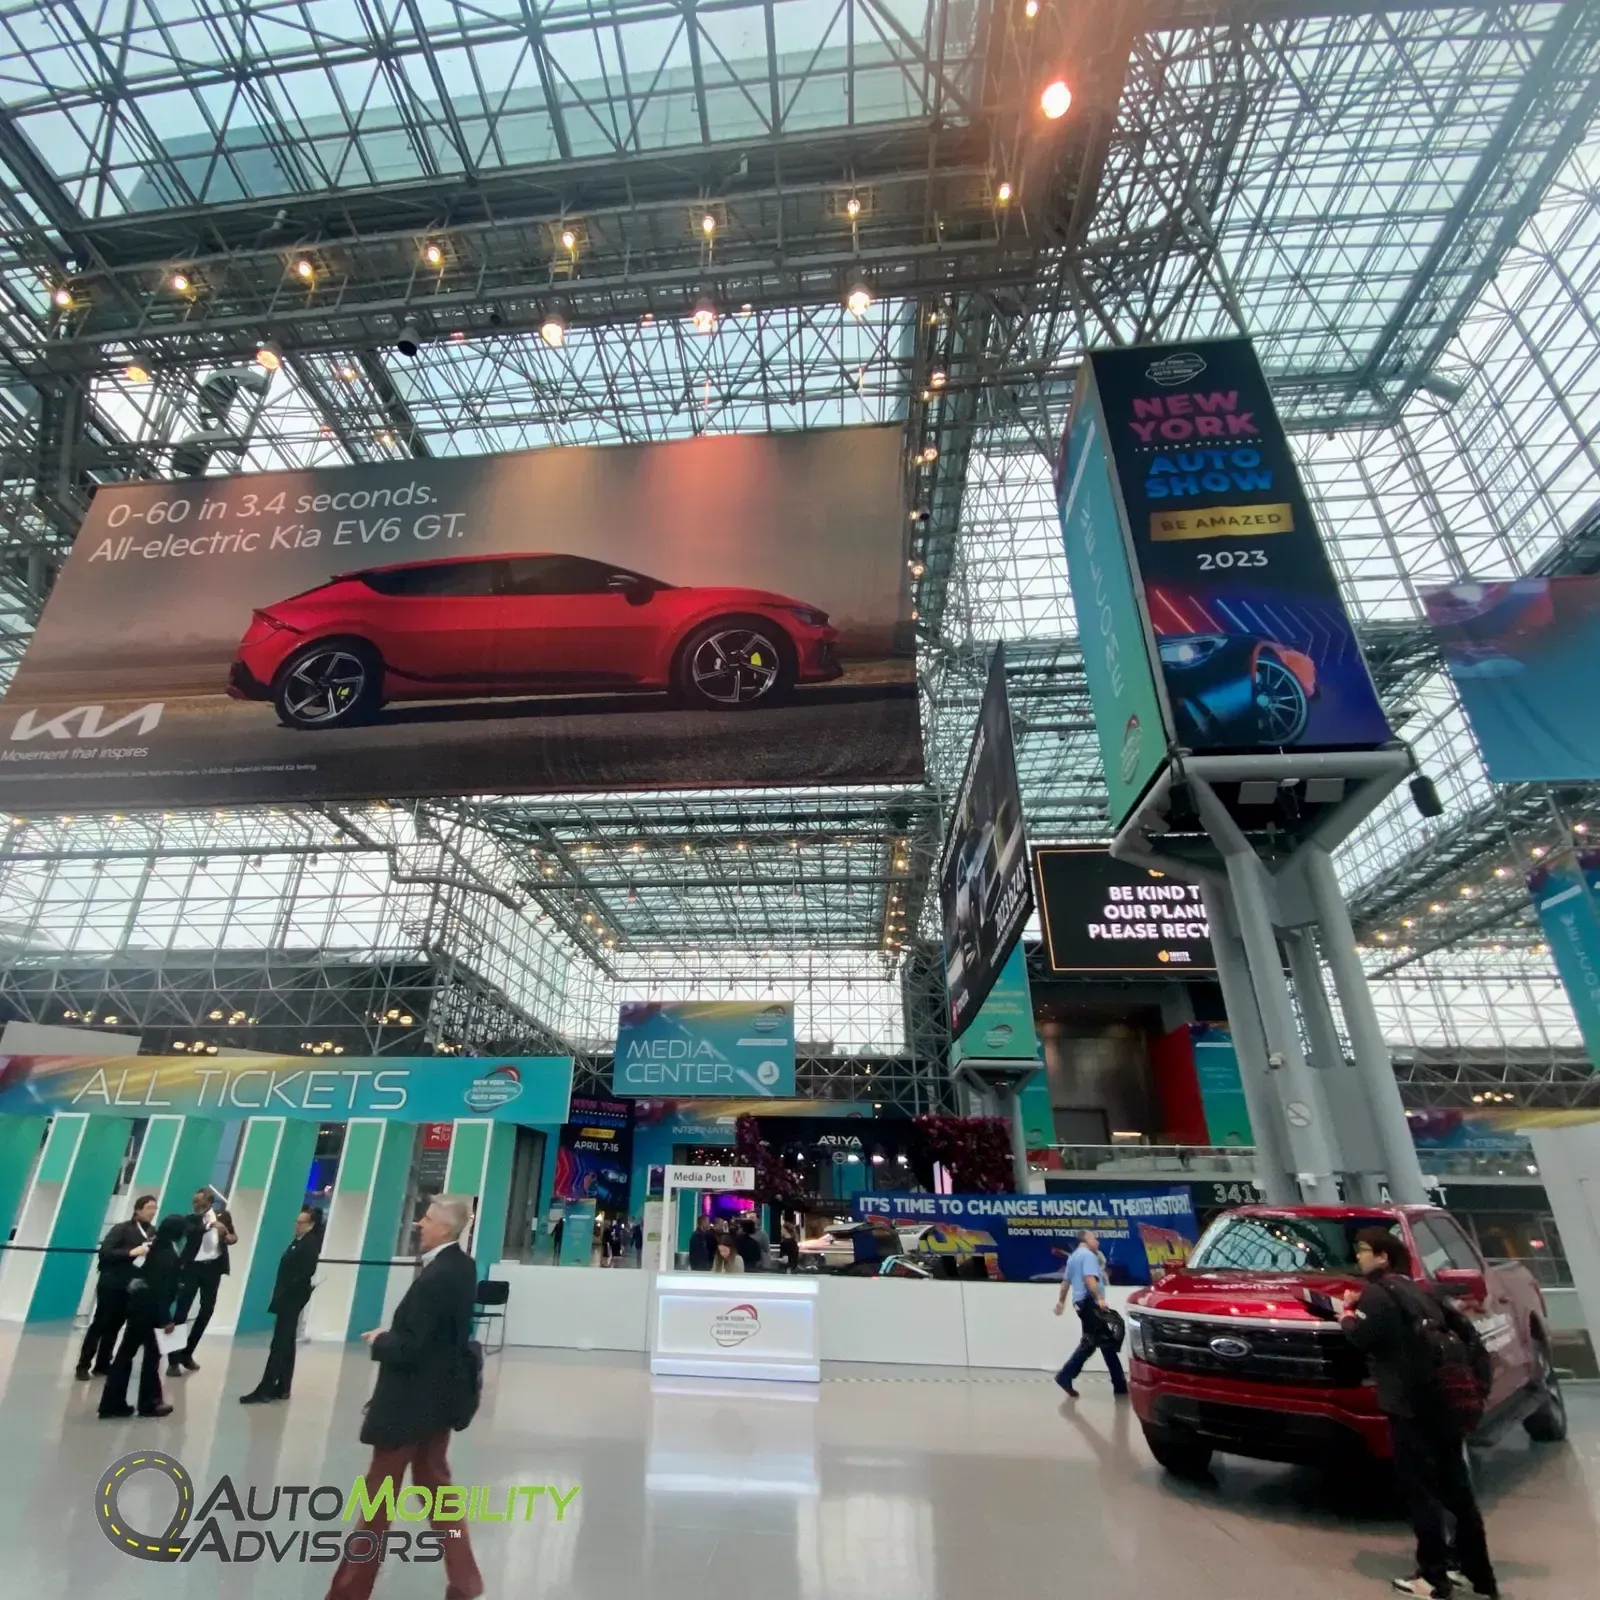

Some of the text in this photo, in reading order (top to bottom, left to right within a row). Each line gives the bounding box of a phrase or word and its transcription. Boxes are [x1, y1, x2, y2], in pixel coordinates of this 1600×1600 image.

[1132, 390, 1239, 419] NEW
[1128, 411, 1259, 443] YORK
[1134, 438, 1263, 452] INTERNATIONAL
[1149, 449, 1262, 474] AUTO
[1144, 470, 1273, 498] SHOW
[107, 481, 438, 528] 0-60 in 3.4 seconds.
[1161, 513, 1282, 531] BE AMAZED
[88, 512, 466, 563] All-electric Kia EV6 GT.
[1197, 550, 1269, 570] 2023
[10, 702, 165, 740] KIA
[0, 746, 149, 762] Movement that inspires
[1108, 885, 1200, 901] BE KIND T
[1103, 904, 1207, 919] OUR PLAN
[1087, 923, 1210, 939] PLEASE RECY
[626, 1039, 714, 1059] MEDIA
[625, 1063, 734, 1083] CENTER
[71, 1068, 410, 1109] ALL TICKETS
[672, 1126, 736, 1136] INTERNATI
[817, 1135, 862, 1146] ARIYA
[574, 1140, 619, 1153] APRIL 7-16
[673, 1171, 726, 1183] Media Post
[859, 1197, 890, 1212] IT'S
[894, 1198, 936, 1214] TIME
[939, 1199, 964, 1215] TO
[967, 1200, 1039, 1216] CHANGE
[1042, 1199, 1108, 1216] MUSICAL
[1109, 1198, 1154, 1216] THEATER
[1008, 1228, 1030, 1236] BOOK
[1031, 1228, 1053, 1237] YOUR
[1054, 1228, 1077, 1238] TICKET
